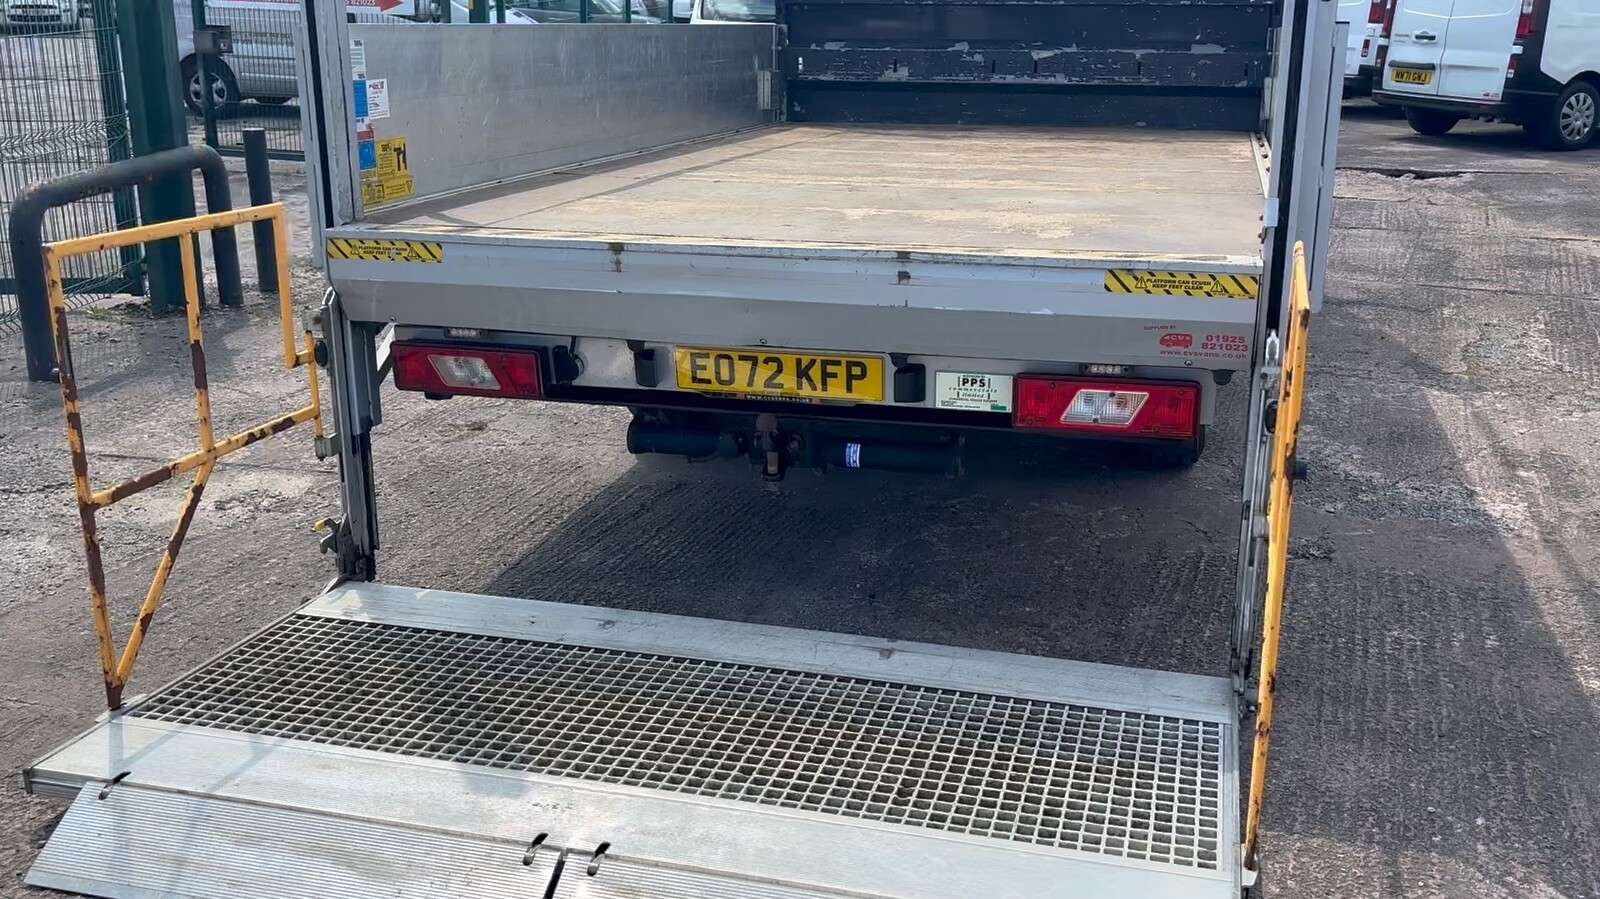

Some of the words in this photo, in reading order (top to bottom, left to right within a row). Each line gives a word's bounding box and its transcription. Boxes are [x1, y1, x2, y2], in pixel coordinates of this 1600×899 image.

[1206, 335, 1246, 343] 01925
[1201, 342, 1248, 351] 821023
[795, 358, 868, 393] KFP
[961, 378, 987, 388] PPS
